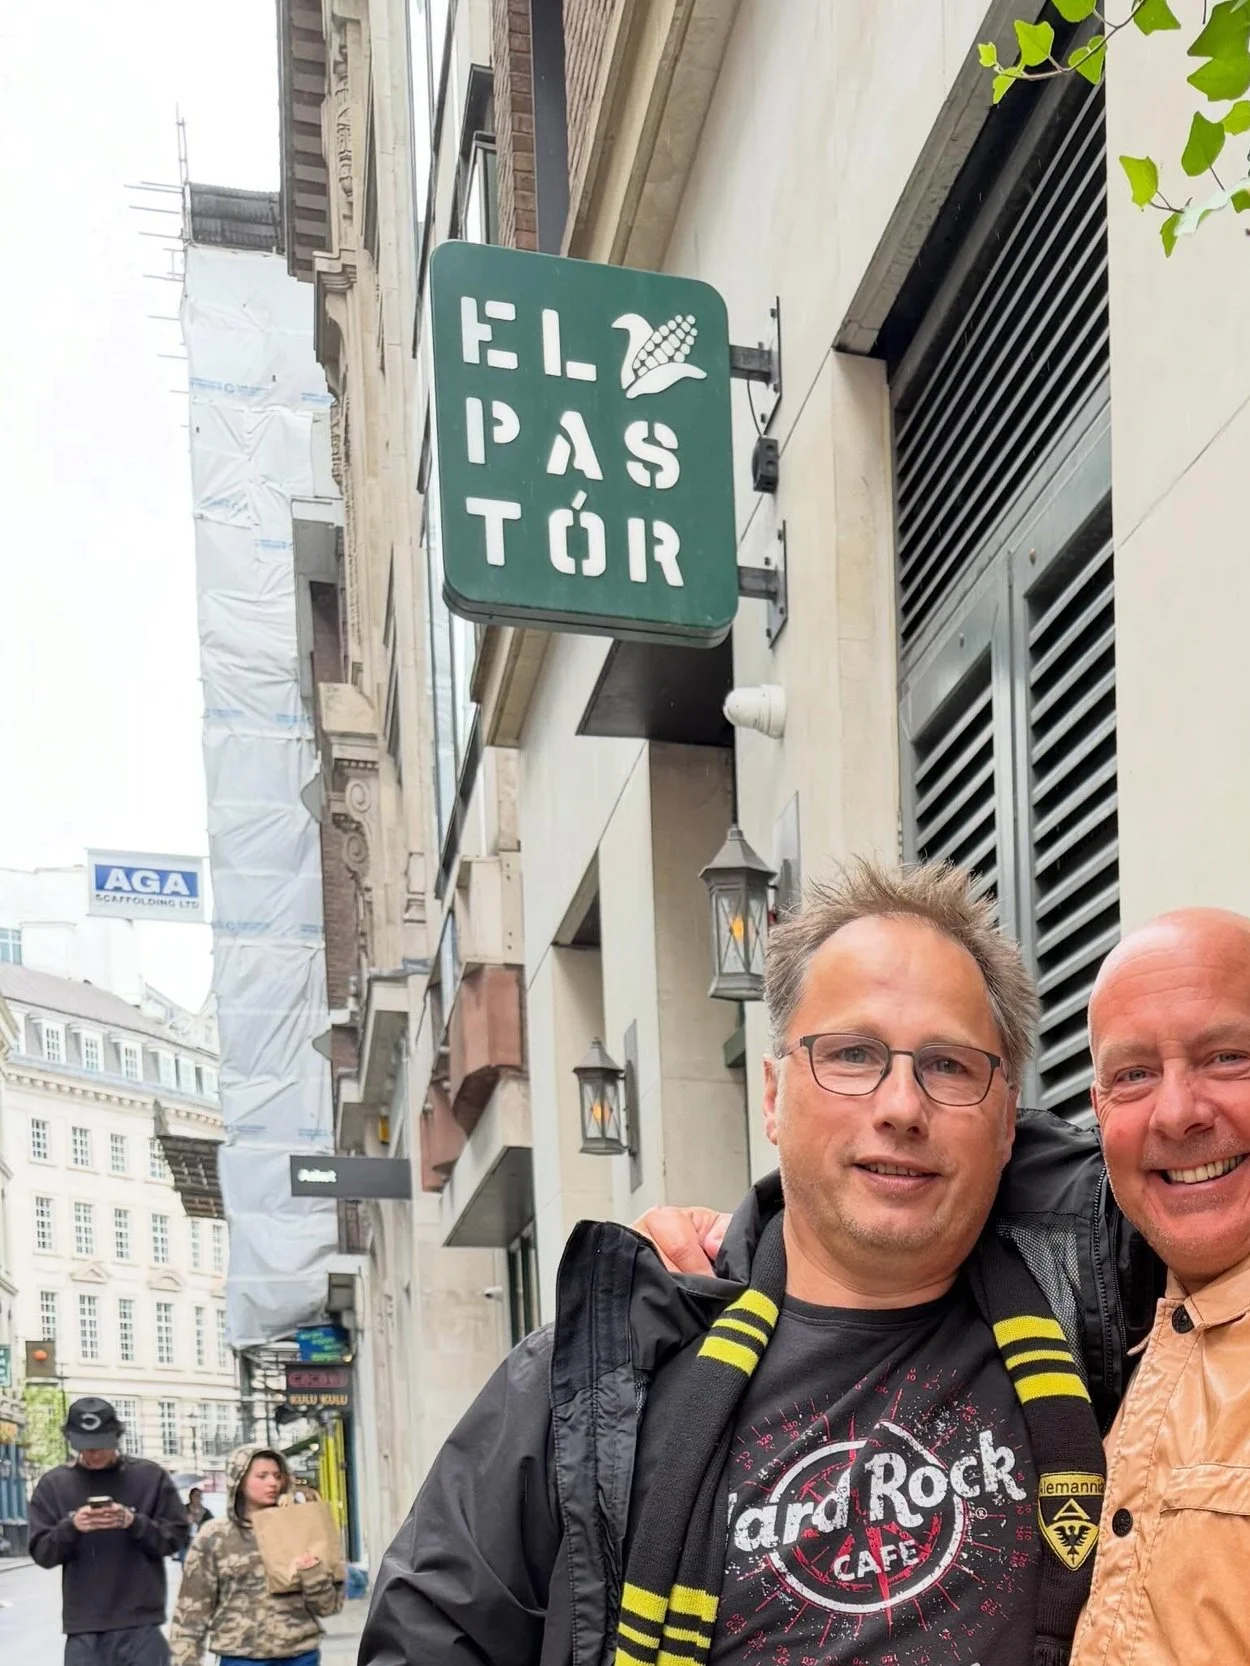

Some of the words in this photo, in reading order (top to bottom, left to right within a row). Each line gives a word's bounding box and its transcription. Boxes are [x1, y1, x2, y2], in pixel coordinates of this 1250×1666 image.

[460, 296, 598, 383] EL
[465, 396, 681, 490] PAS
[465, 490, 685, 588] TÓR
[95, 893, 176, 908] SCAFFOLDING
[180, 899, 200, 909] LTD
[103, 867, 191, 896] AGA
[865, 1429, 1027, 1529] Rock
[833, 1538, 920, 1582] CAFE
